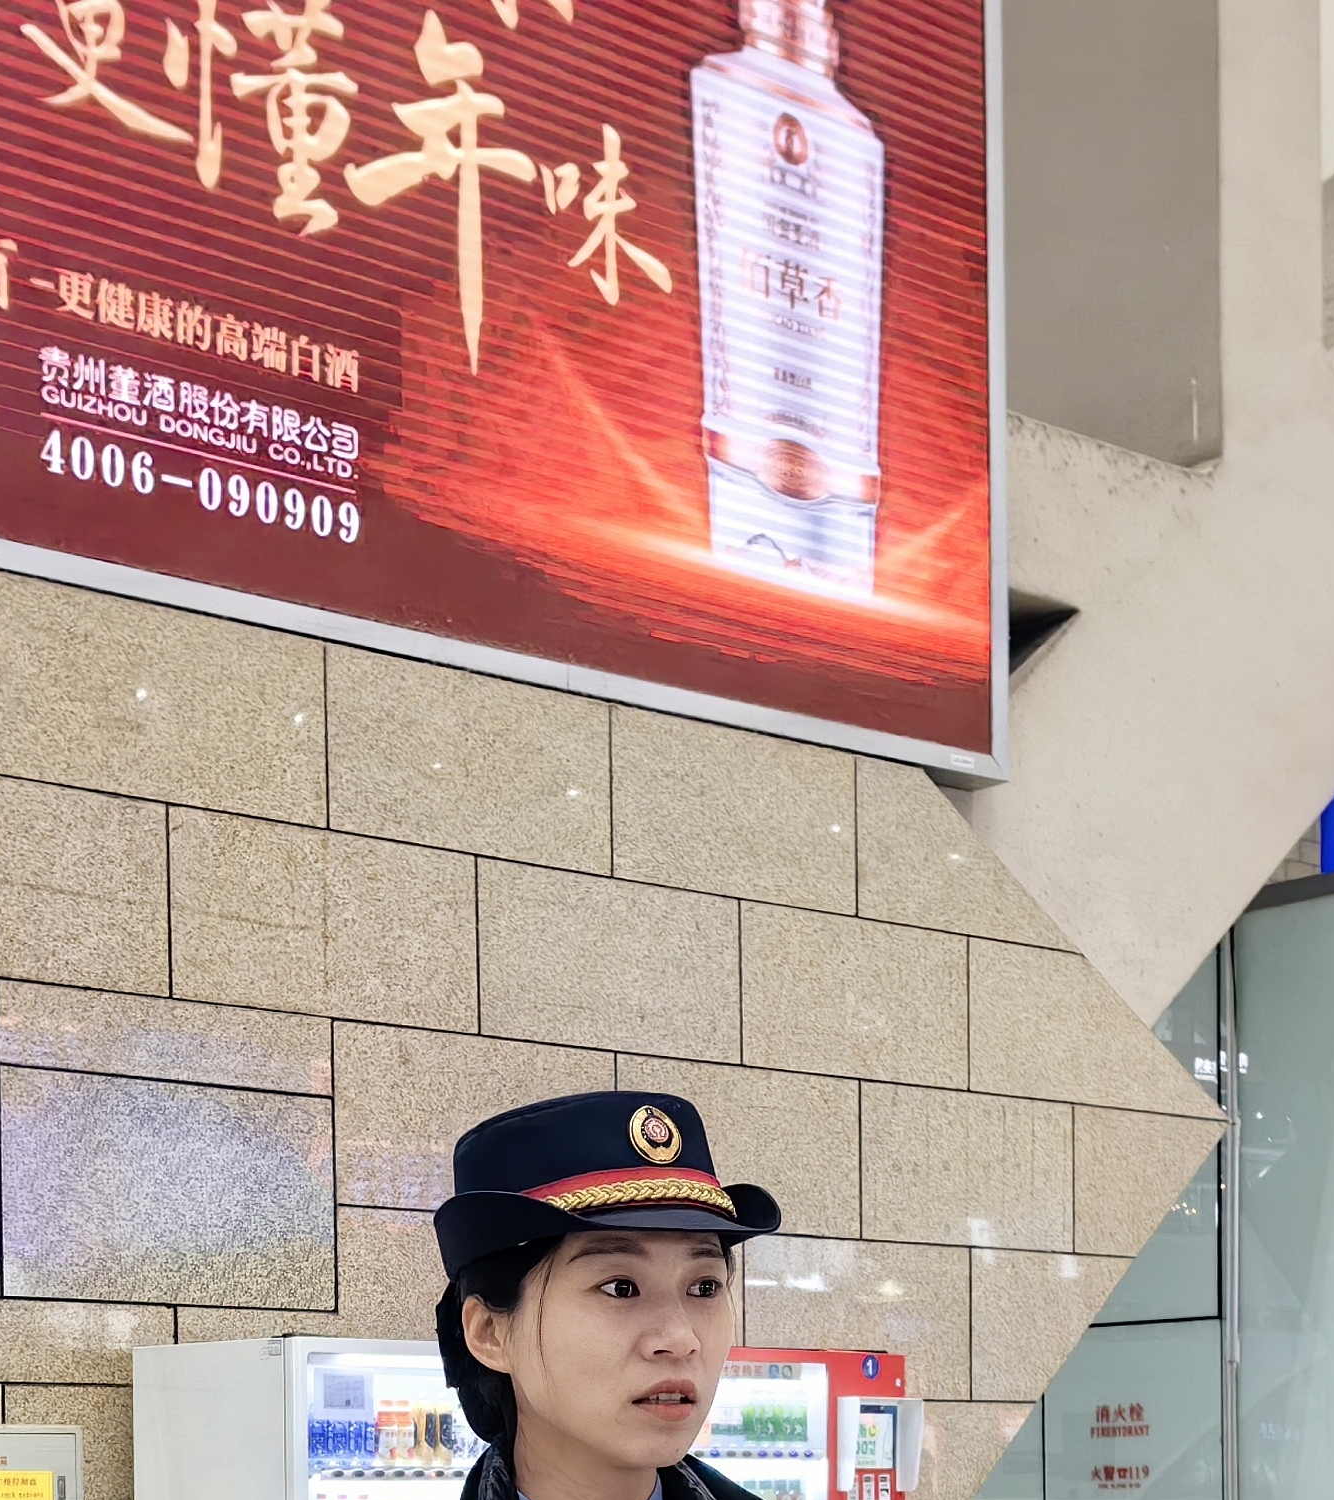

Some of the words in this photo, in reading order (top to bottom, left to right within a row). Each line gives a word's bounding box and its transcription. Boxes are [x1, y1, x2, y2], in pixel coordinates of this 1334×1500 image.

[21, 0, 673, 376] 更懂年味
[38, 345, 360, 461] 贵州董酒股份有限公司
[40, 385, 148, 427] GUIZHOU
[159, 414, 258, 455] DONGJIU
[268, 442, 359, 480] CO.,LTD.
[40, 429, 361, 544] 4006-090909
[1096, 1402, 1146, 1423] 消火栓
